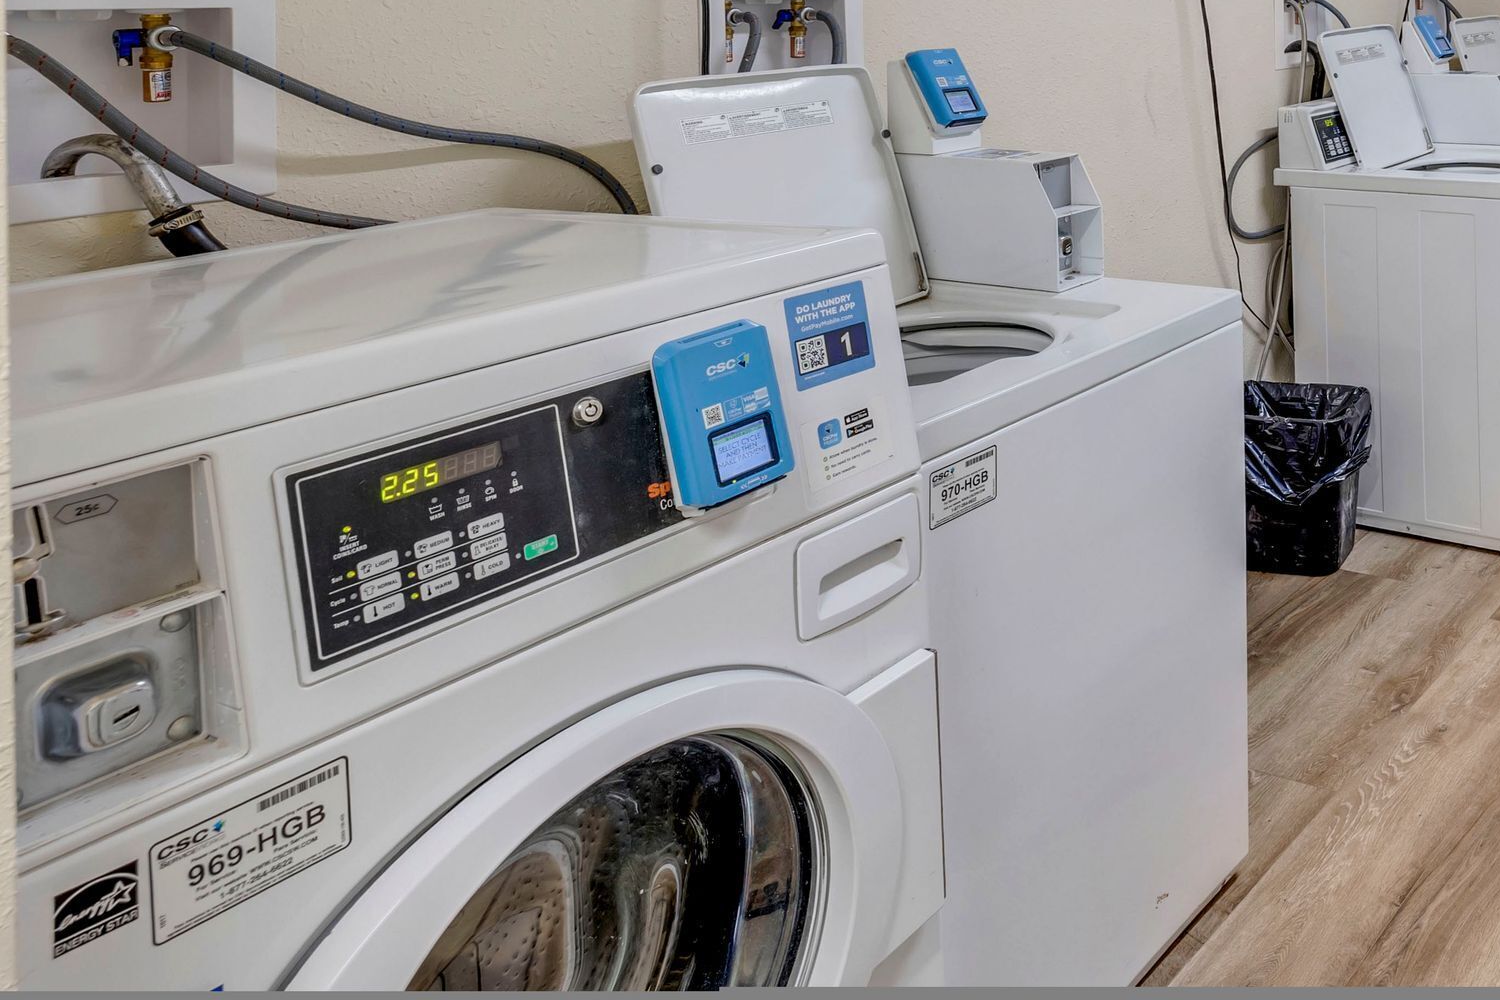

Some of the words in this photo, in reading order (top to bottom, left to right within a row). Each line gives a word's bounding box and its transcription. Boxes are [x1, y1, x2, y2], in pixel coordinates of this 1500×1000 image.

[796, 305, 809, 315] DO
[812, 294, 852, 311] LAUNDRY
[795, 312, 819, 324] WITH
[820, 306, 838, 318] THE
[839, 302, 856, 313] APP
[801, 314, 854, 332] GetPayMobile.com
[841, 332, 852, 356] 1
[706, 358, 736, 377] CSC
[719, 440, 740, 453] SELECT
[741, 433, 761, 445] CYCLE
[726, 448, 740, 458] AND
[741, 442, 758, 453] THEN
[738, 445, 767, 460] PAYMENT
[932, 470, 949, 483] CSC
[381, 463, 439, 502] 2.25
[941, 471, 988, 502] 970-HGB
[485, 494, 497, 502] SPIN
[457, 503, 472, 512] RINSE
[429, 511, 445, 521] WASH
[482, 519, 500, 529] HEAVY
[339, 541, 360, 552] INSERT
[429, 537, 450, 548] MEDIUM
[375, 557, 393, 568] LIGHT
[435, 556, 450, 565] PERM
[435, 561, 452, 570] PRESS
[488, 561, 503, 570] COLD
[377, 580, 398, 590] NORMAL
[434, 580, 452, 591] WARM
[330, 598, 346, 607] Cycle
[383, 602, 395, 610] HOT
[333, 620, 349, 629] Temp
[157, 828, 209, 861] CSC
[188, 804, 326, 887] 969-HGB
[55, 925, 105, 956] ENERGY
[105, 910, 138, 932] STAR
